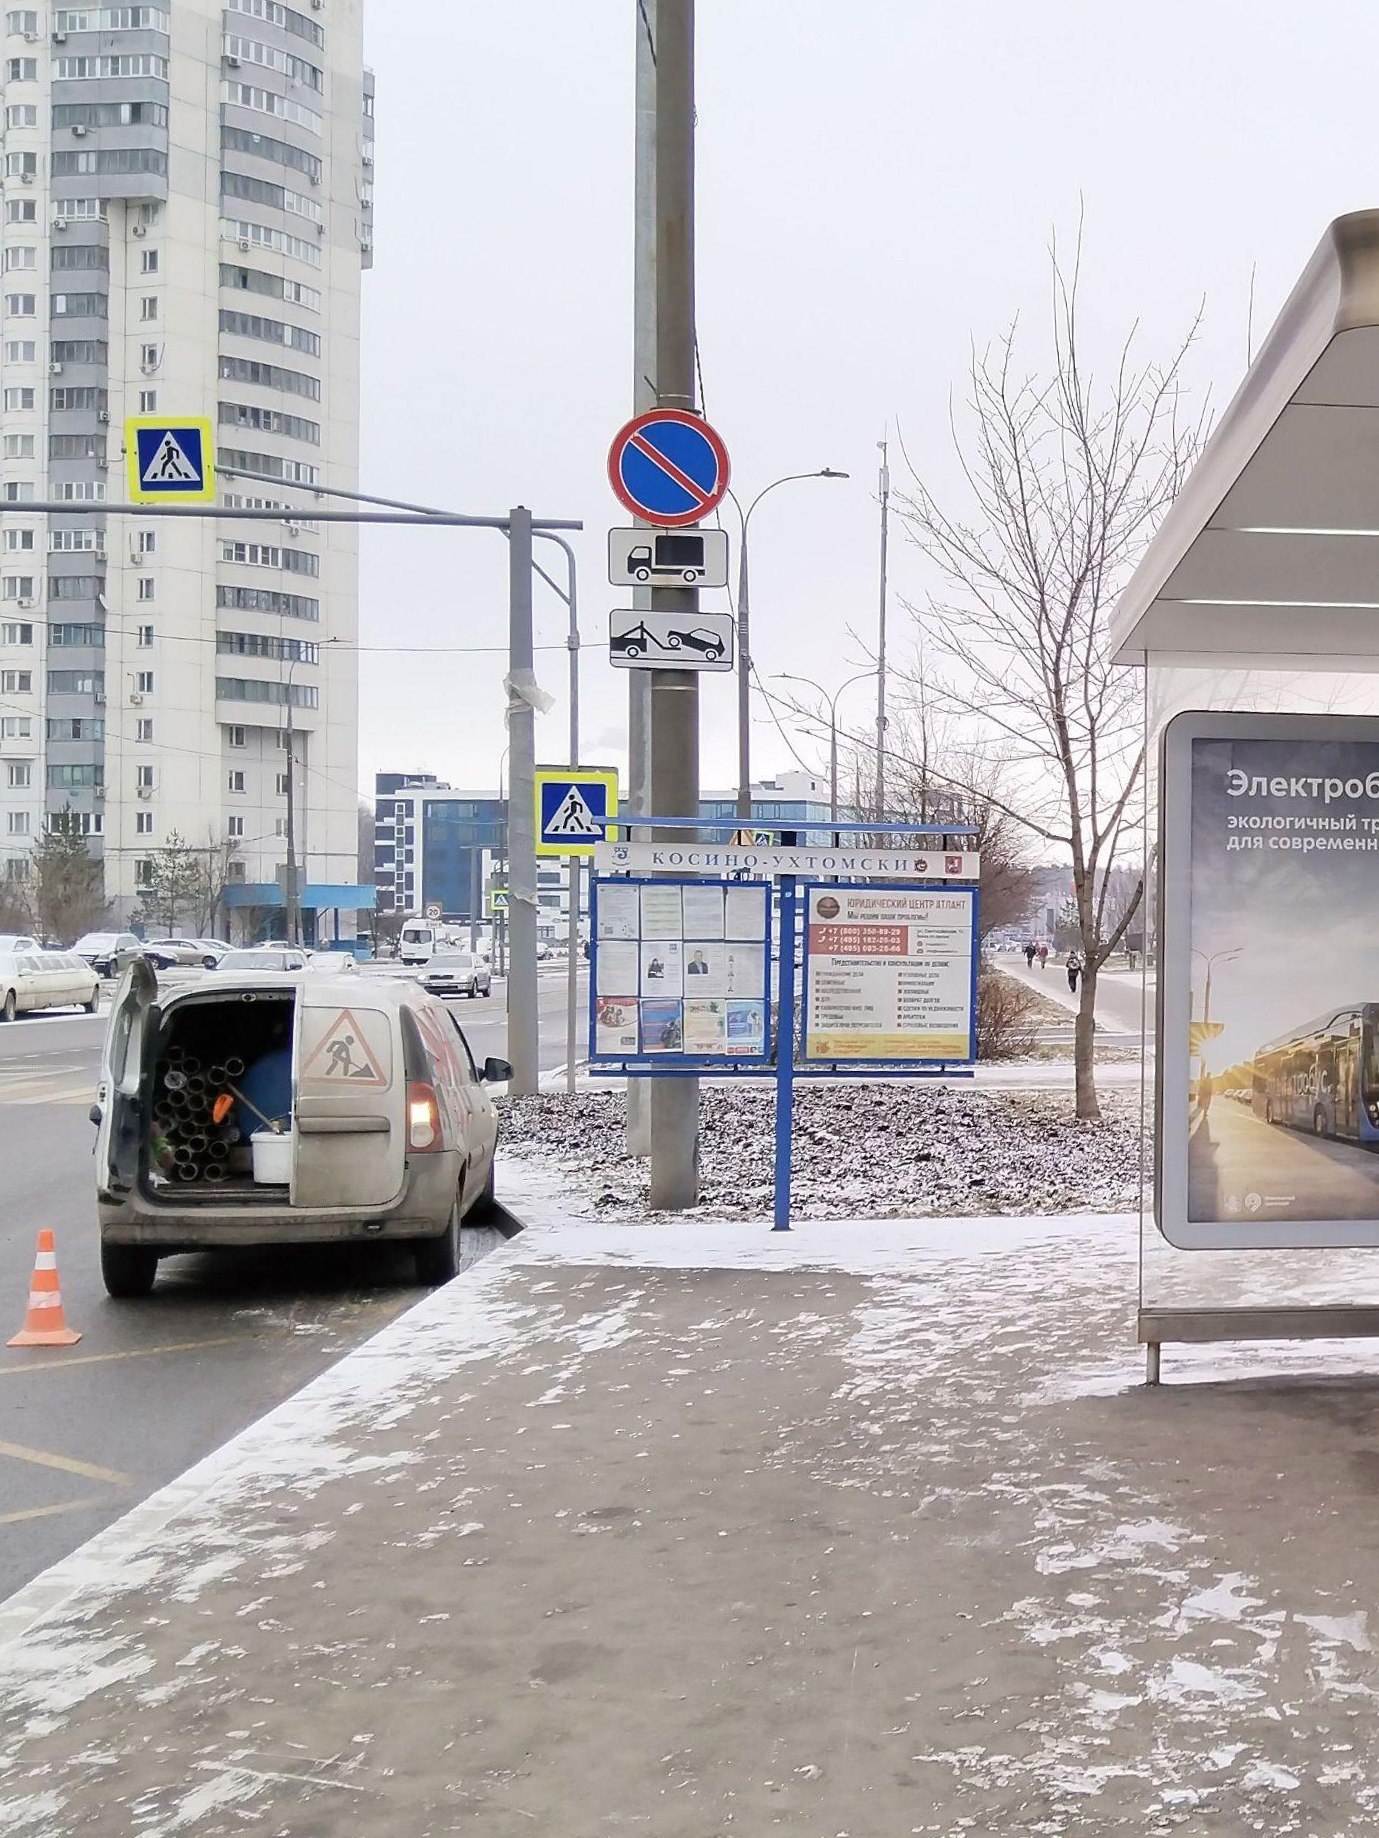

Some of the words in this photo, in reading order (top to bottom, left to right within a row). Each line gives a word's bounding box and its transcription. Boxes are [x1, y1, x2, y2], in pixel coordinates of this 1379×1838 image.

[1227, 814, 1357, 831] экологичный
[1227, 835, 1264, 851] для
[652, 851, 927, 871] КОСИНО-УХТОМСКИ
[429, 908, 438, 916] 20
[847, 898, 907, 909] ЮРИДИЧЕСКИЙ
[909, 899, 934, 909] ЦЕНТР
[936, 899, 966, 910] АТЛАНТ
